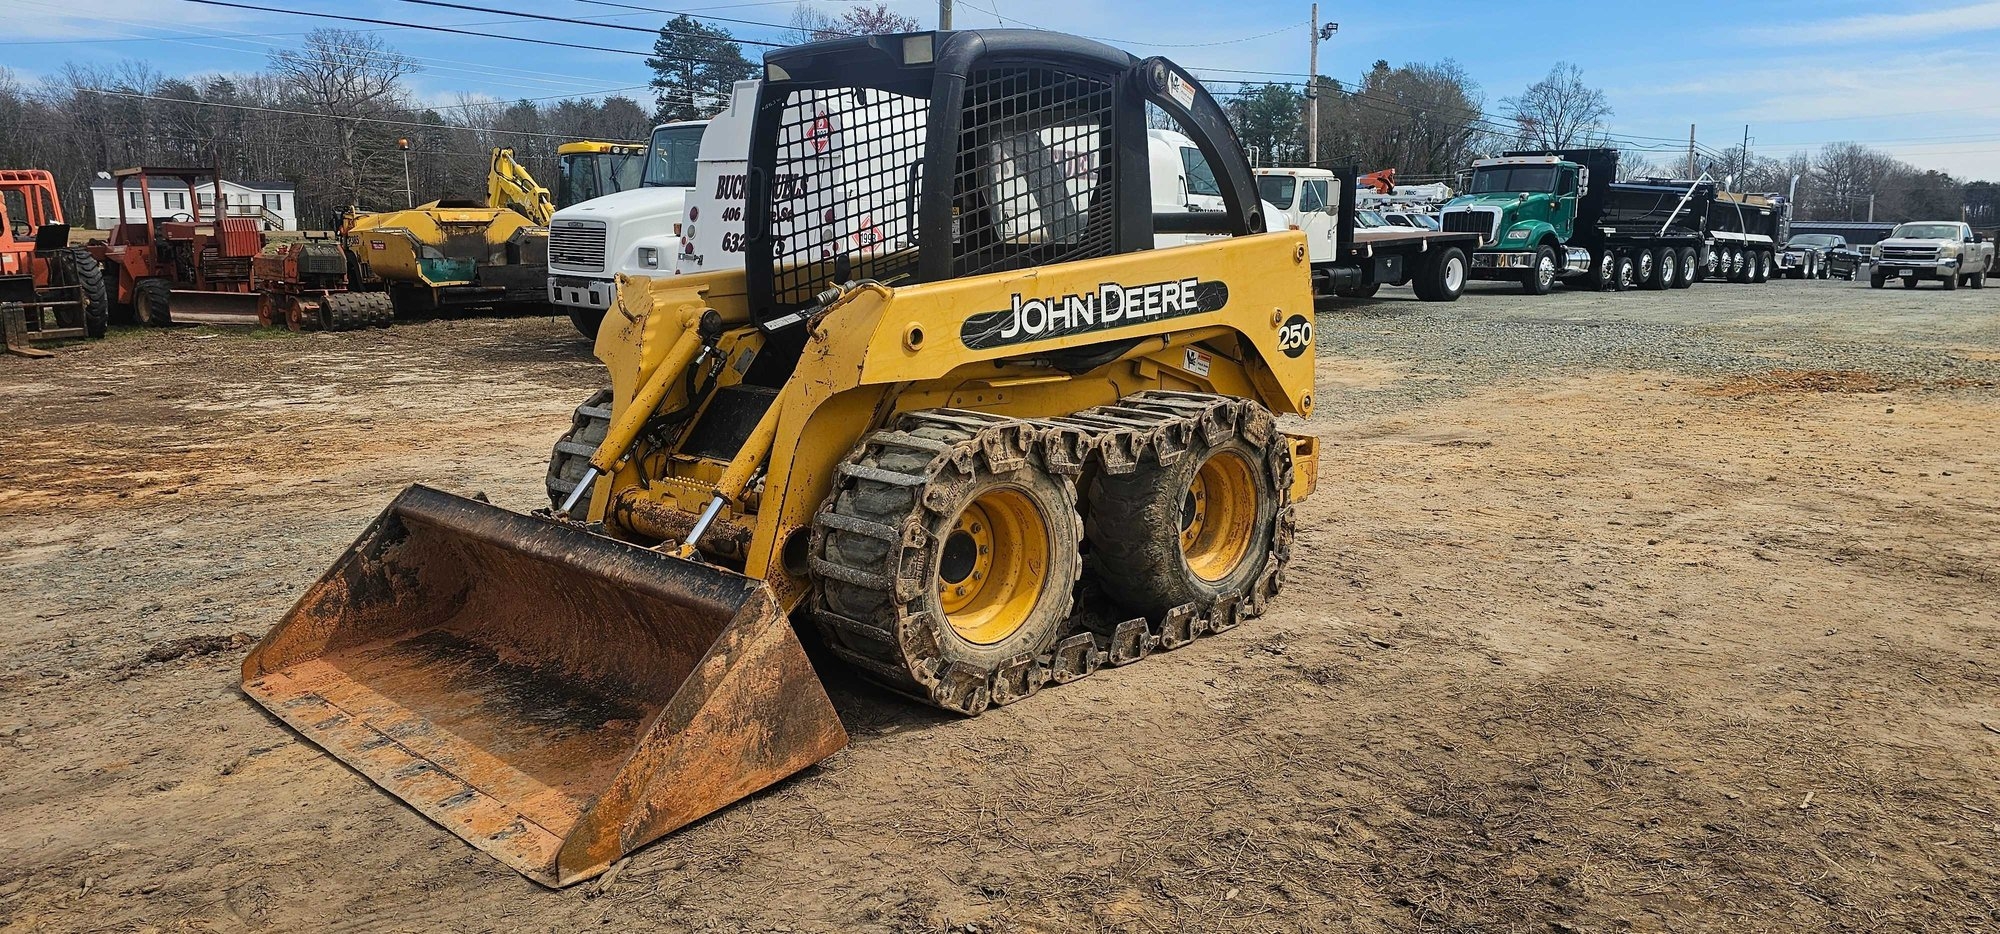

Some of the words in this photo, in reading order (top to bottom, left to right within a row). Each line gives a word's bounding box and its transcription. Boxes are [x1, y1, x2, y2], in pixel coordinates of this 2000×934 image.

[773, 173, 809, 199] UELS
[722, 206, 741, 221] 406
[1001, 294, 1094, 339] JOHN
[1101, 279, 1198, 323] DEERE
[1278, 322, 1312, 350] 250
